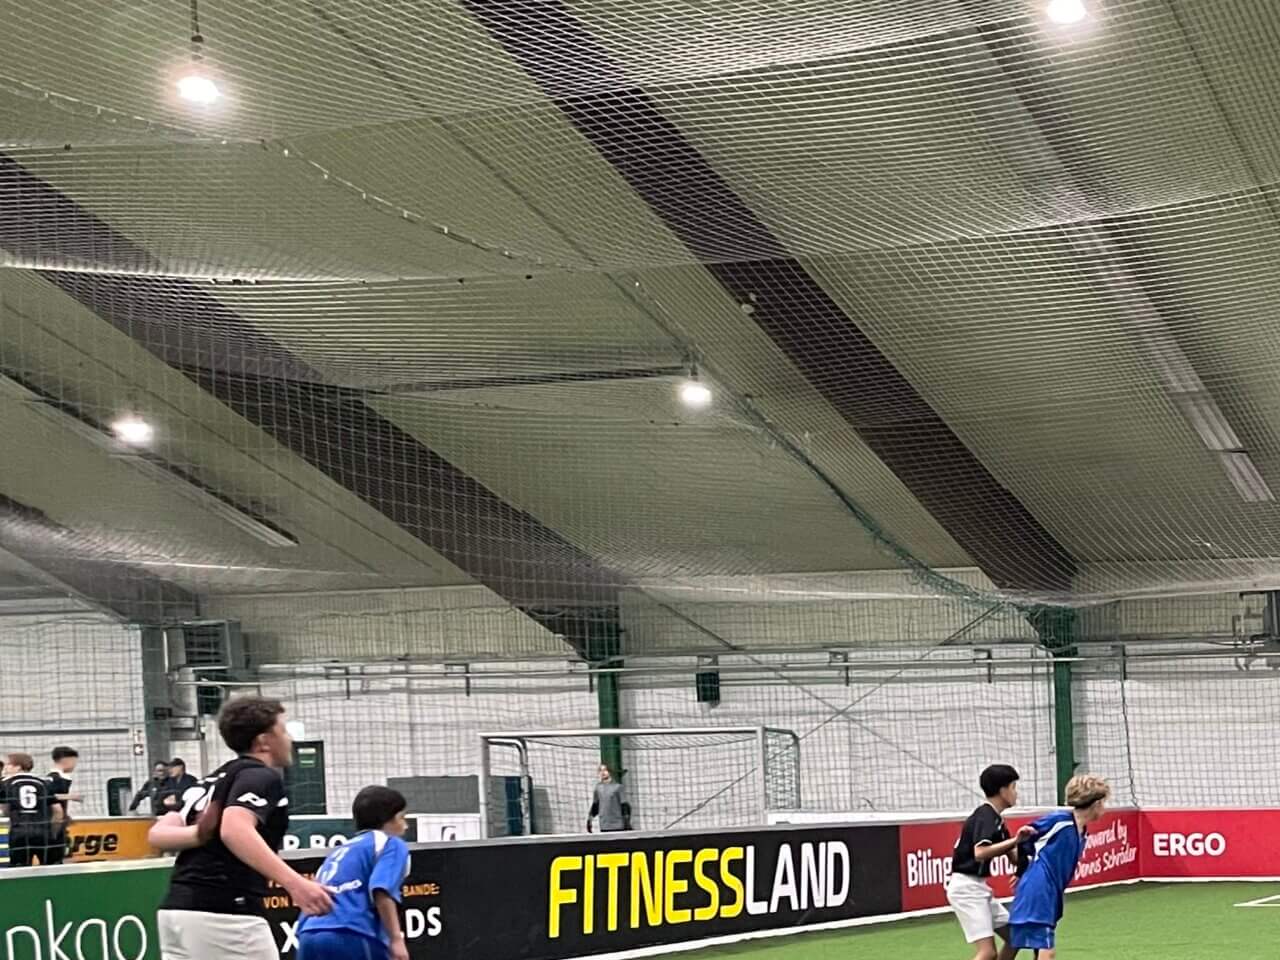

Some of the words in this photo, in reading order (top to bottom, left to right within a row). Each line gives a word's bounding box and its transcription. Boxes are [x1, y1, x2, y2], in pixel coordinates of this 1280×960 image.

[19, 785, 37, 809] 6
[1117, 818, 1128, 845] by
[1152, 832, 1226, 857] ERGO
[549, 841, 850, 938] FITNESSLAND
